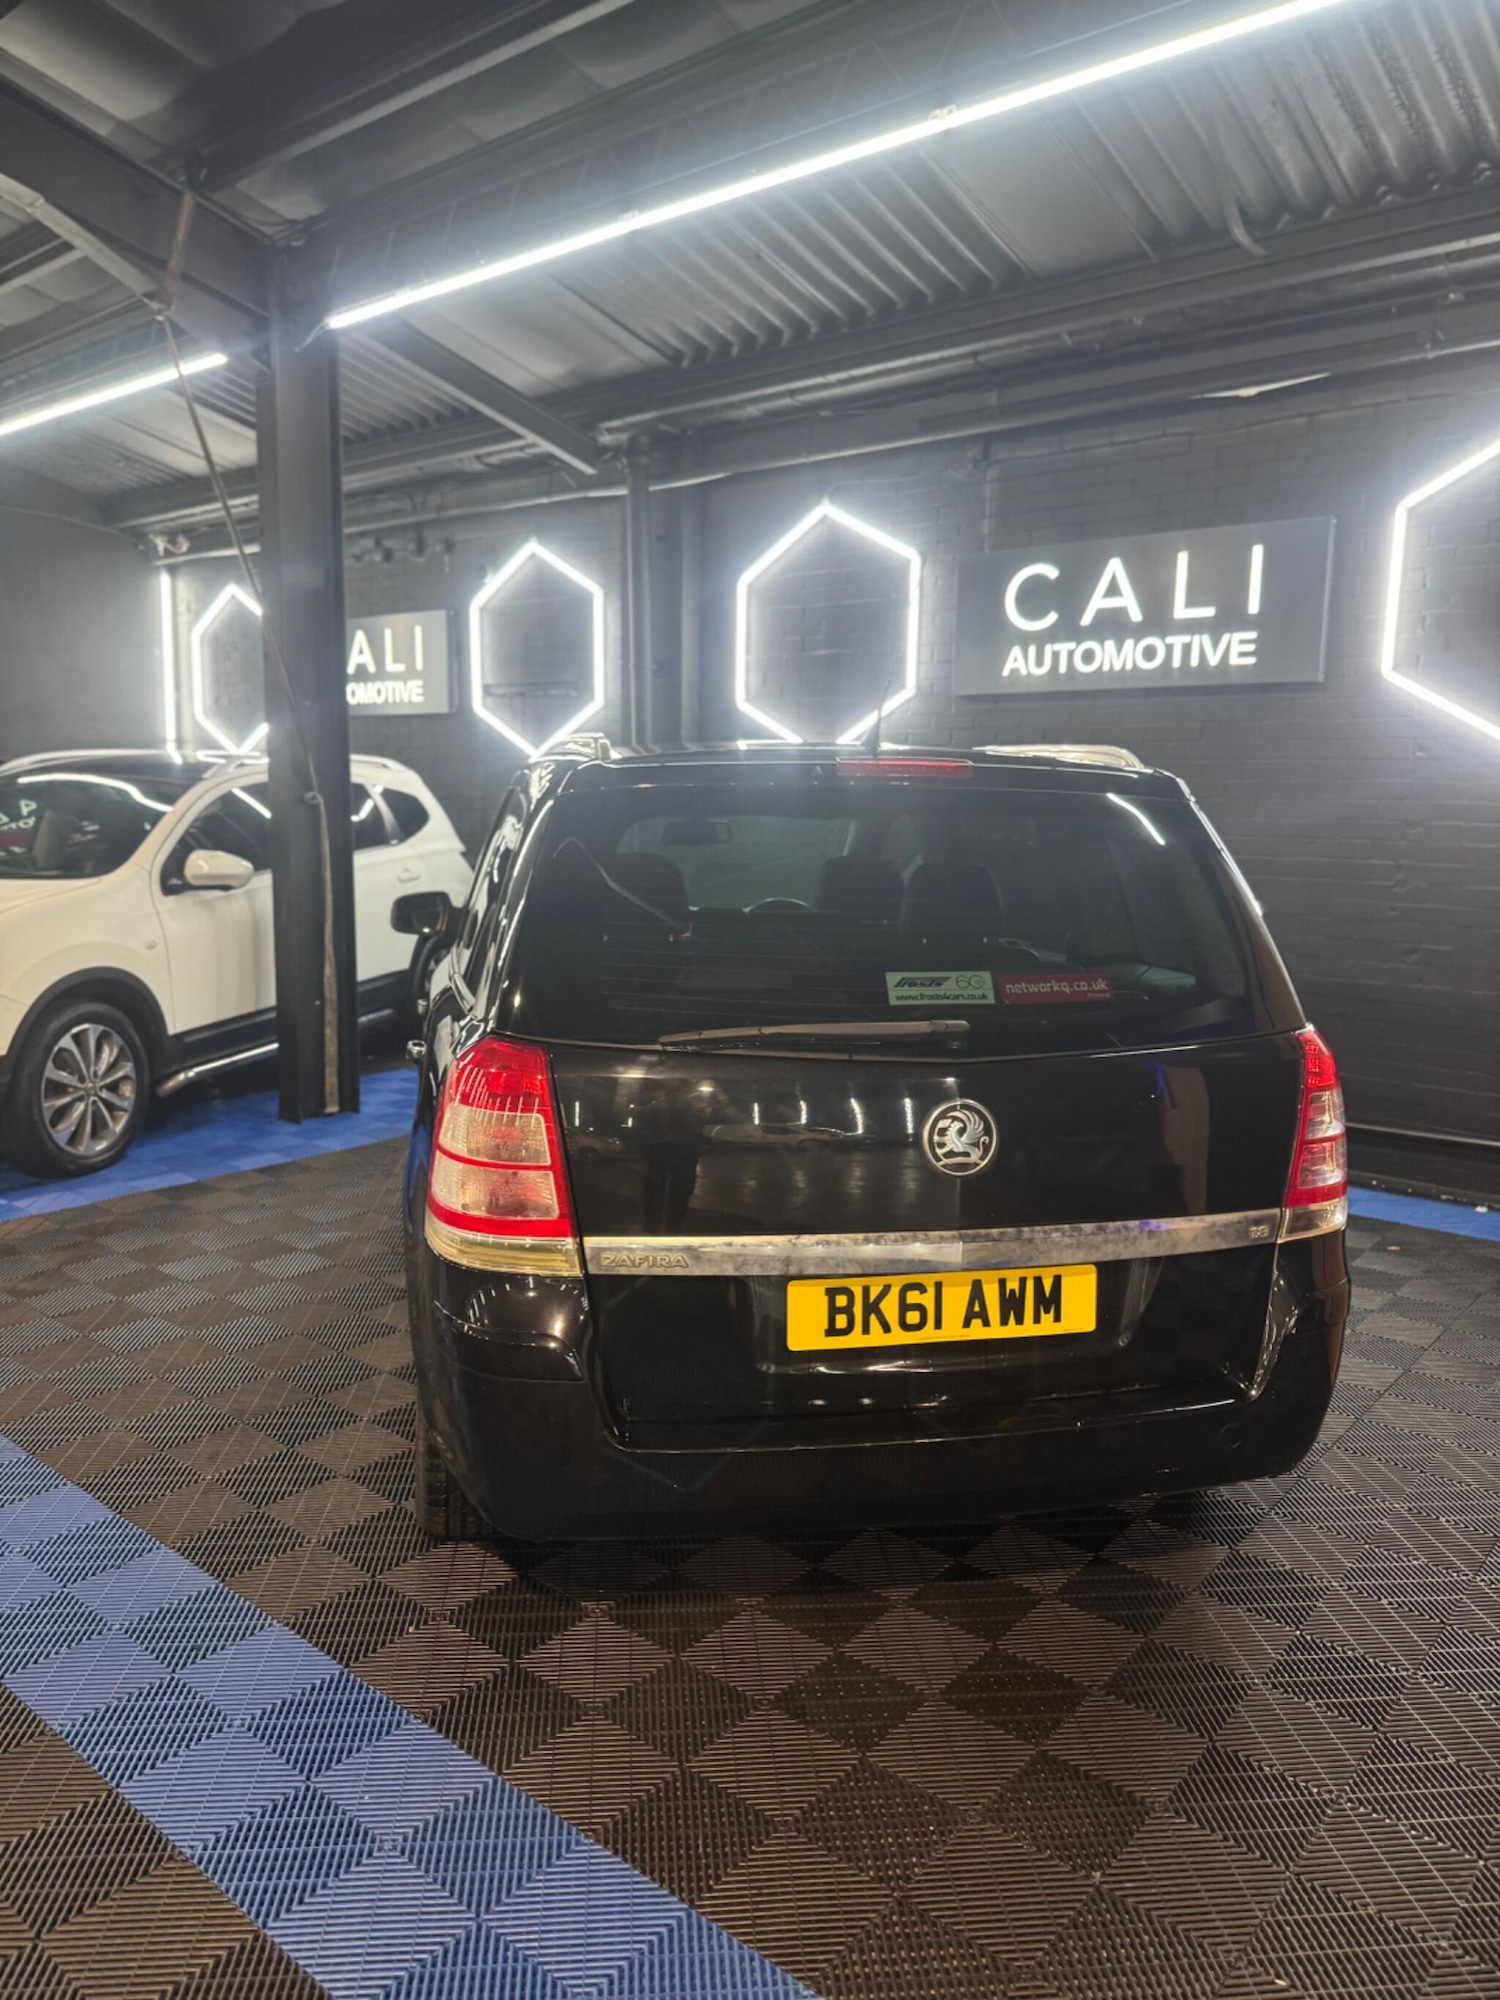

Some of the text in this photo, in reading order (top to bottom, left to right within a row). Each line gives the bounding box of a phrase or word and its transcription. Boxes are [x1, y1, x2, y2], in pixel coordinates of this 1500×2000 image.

[1004, 543, 1265, 632] CALI
[346, 624, 424, 675] ALI
[1002, 632, 1259, 677] AUTOMOTIVE
[345, 679, 425, 705] OMOTIVE
[1006, 978, 1108, 994] networkq.co.uk
[601, 1252, 690, 1268] ZAFIRA
[824, 1274, 1062, 1337] BK61 AWM
